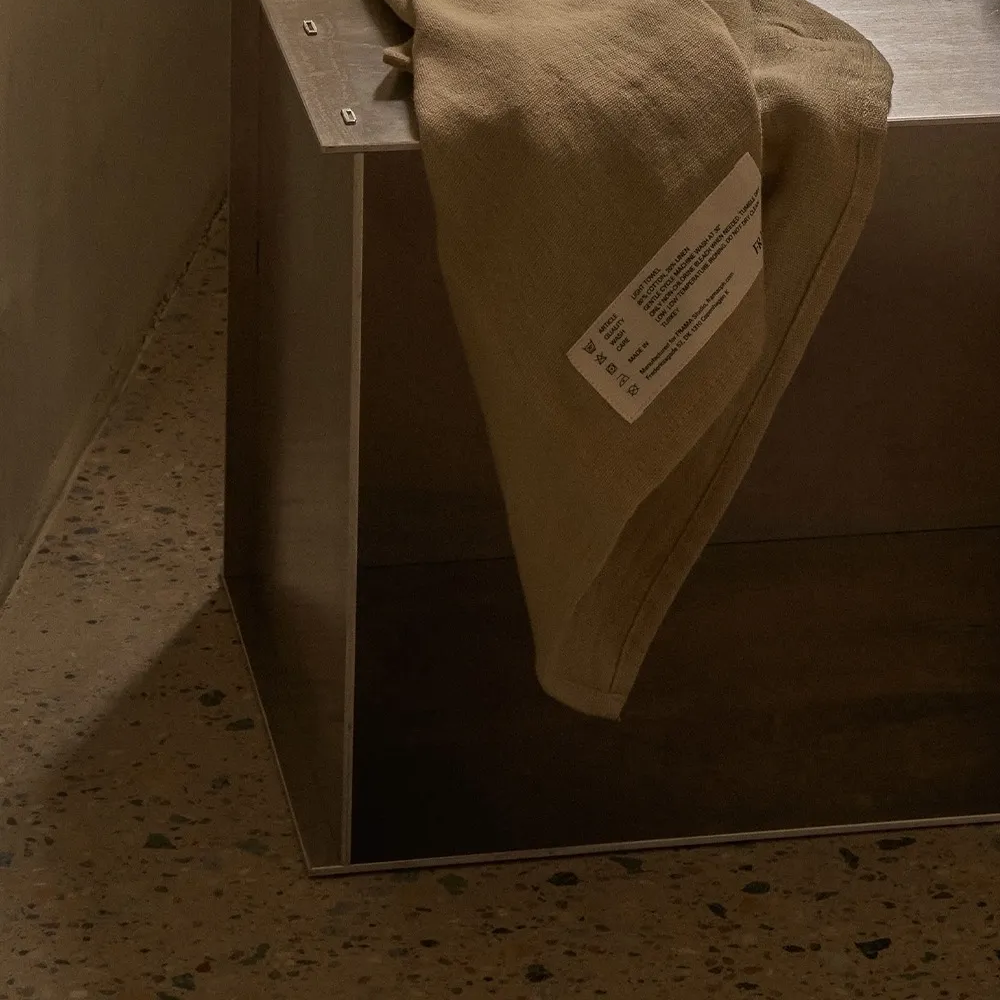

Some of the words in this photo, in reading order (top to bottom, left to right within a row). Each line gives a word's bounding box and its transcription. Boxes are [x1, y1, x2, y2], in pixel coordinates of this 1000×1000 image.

[642, 266, 661, 286] TOWEL
[597, 312, 619, 335] ARTICLE
[660, 306, 681, 328] TURKEY
[602, 316, 626, 341] QUALITY
[609, 328, 626, 347] WASH
[615, 336, 631, 353] CARE
[627, 346, 644, 364] MADE
